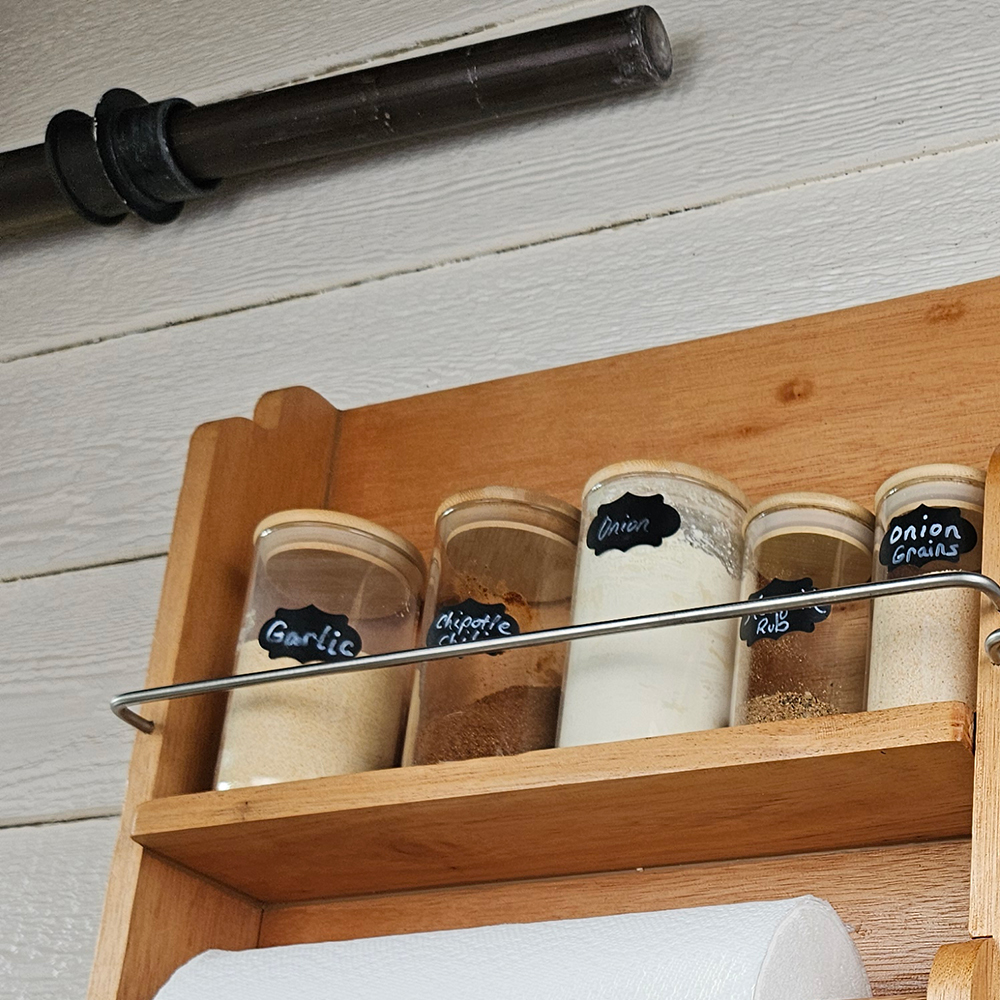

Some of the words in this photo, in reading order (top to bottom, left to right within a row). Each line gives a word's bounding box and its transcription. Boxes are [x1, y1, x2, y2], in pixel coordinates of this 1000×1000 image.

[598, 514, 650, 541] Onion
[890, 514, 961, 544] Onion
[892, 539, 959, 564] Grains
[757, 612, 789, 635] Rub
[266, 619, 355, 657] Garlic
